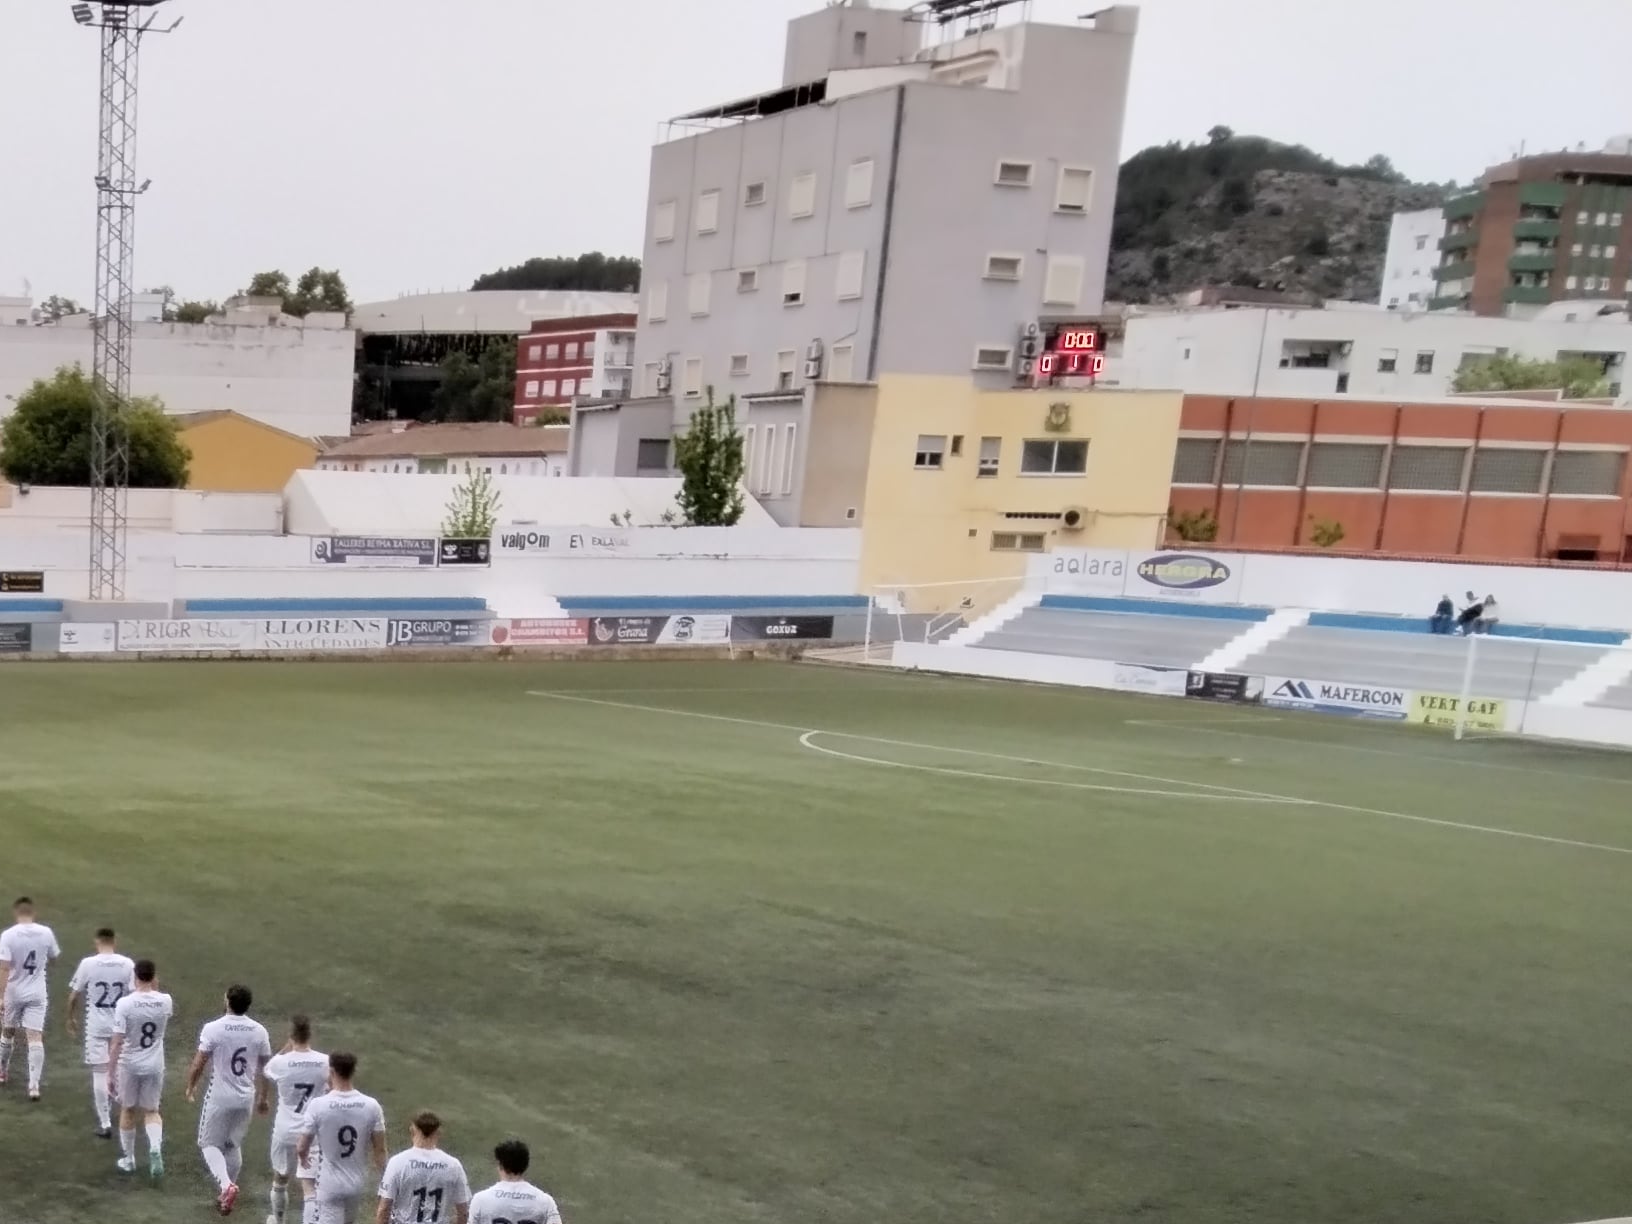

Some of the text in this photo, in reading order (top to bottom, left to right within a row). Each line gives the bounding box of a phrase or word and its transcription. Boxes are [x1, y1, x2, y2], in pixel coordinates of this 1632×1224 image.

[1064, 332, 1094, 348] 0:00
[1041, 356, 1052, 372] 0
[1093, 356, 1104, 372] 0
[264, 620, 381, 635] LLORENS
[413, 621, 452, 633] GRUPO
[1319, 684, 1404, 706] MAFERCON
[23, 950, 37, 976] 4
[95, 981, 124, 1009] 22
[139, 1021, 157, 1049] 8
[230, 1046, 248, 1077] 6
[294, 1083, 315, 1114] 7
[337, 1124, 359, 1158] 9
[413, 1186, 444, 1223] 11
